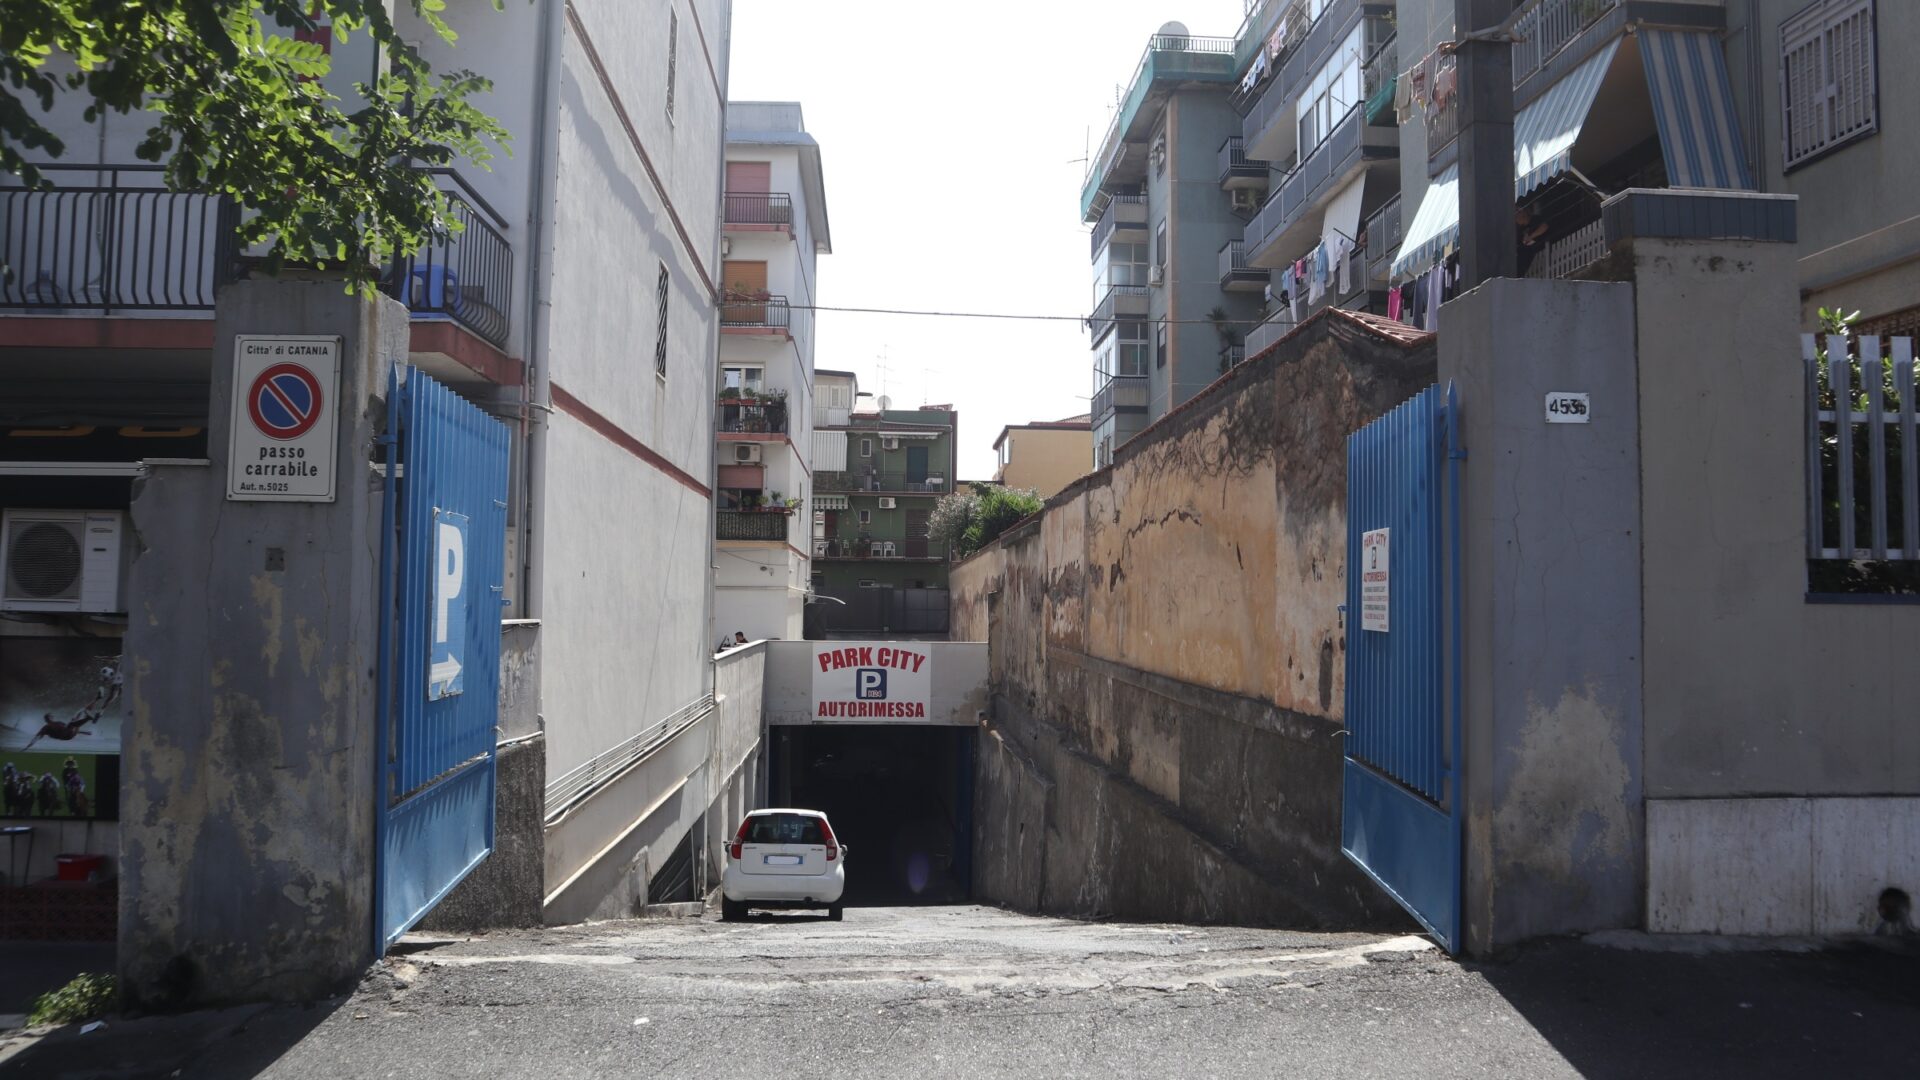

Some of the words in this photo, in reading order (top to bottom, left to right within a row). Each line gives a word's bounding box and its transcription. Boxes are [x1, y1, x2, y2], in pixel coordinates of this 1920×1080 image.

[275, 346, 284, 355] di
[288, 346, 328, 355] CATANIA
[260, 447, 305, 461] passo
[245, 461, 318, 477] carrabile
[240, 482, 257, 491] Aut.
[436, 522, 464, 643] P
[818, 647, 873, 672] PARK
[877, 647, 926, 673] CITY
[861, 671, 882, 698] P
[818, 702, 925, 717] AUTORIMESSA
